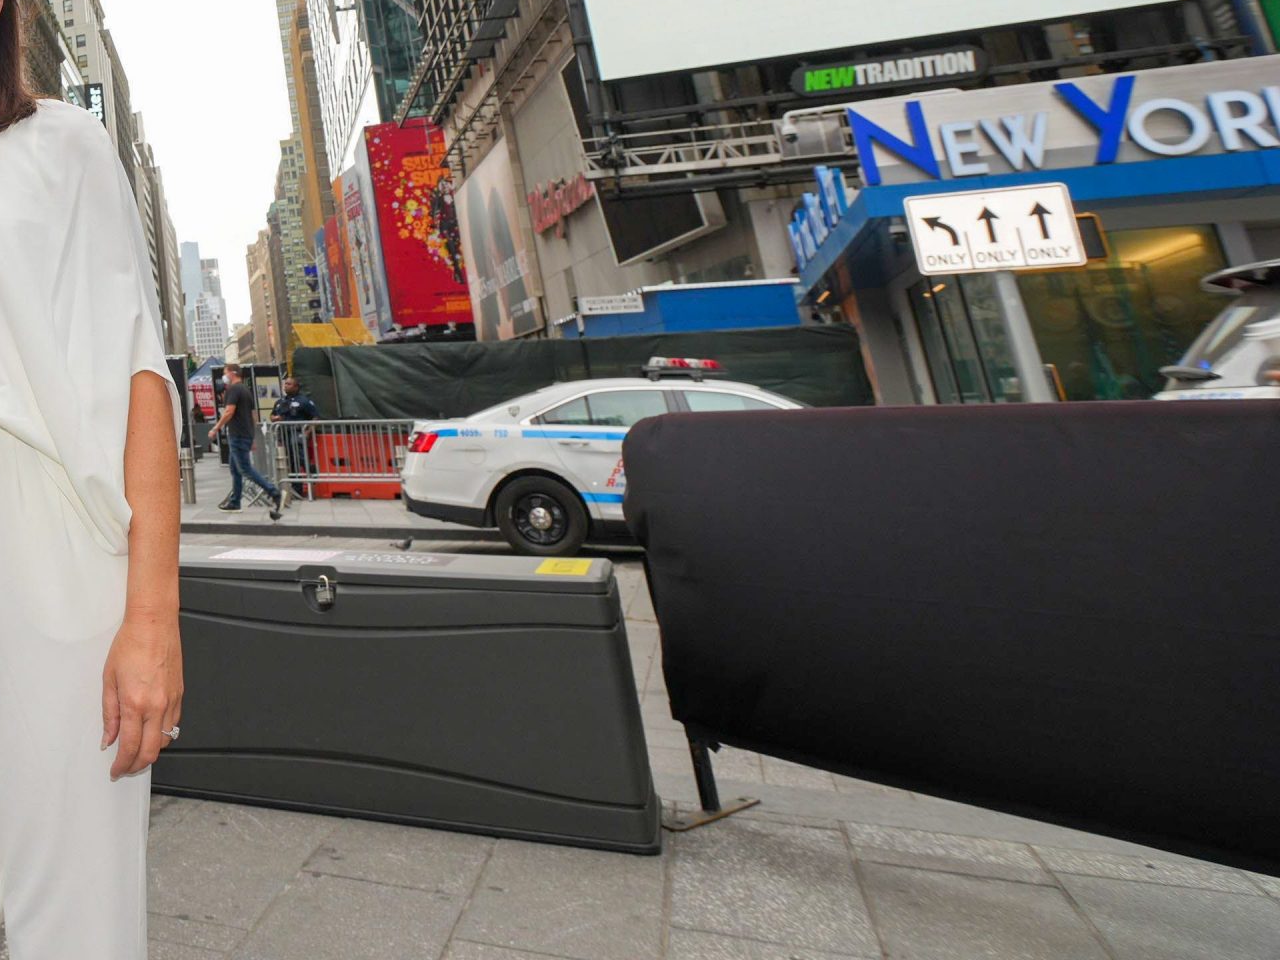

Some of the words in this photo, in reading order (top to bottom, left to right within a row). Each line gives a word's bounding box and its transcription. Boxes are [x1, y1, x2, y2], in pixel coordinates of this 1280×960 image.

[803, 49, 976, 93] NEWTRADITION
[926, 253, 968, 267] ONLY
[976, 250, 1020, 265] ONLY
[1027, 245, 1072, 261] ONLY
